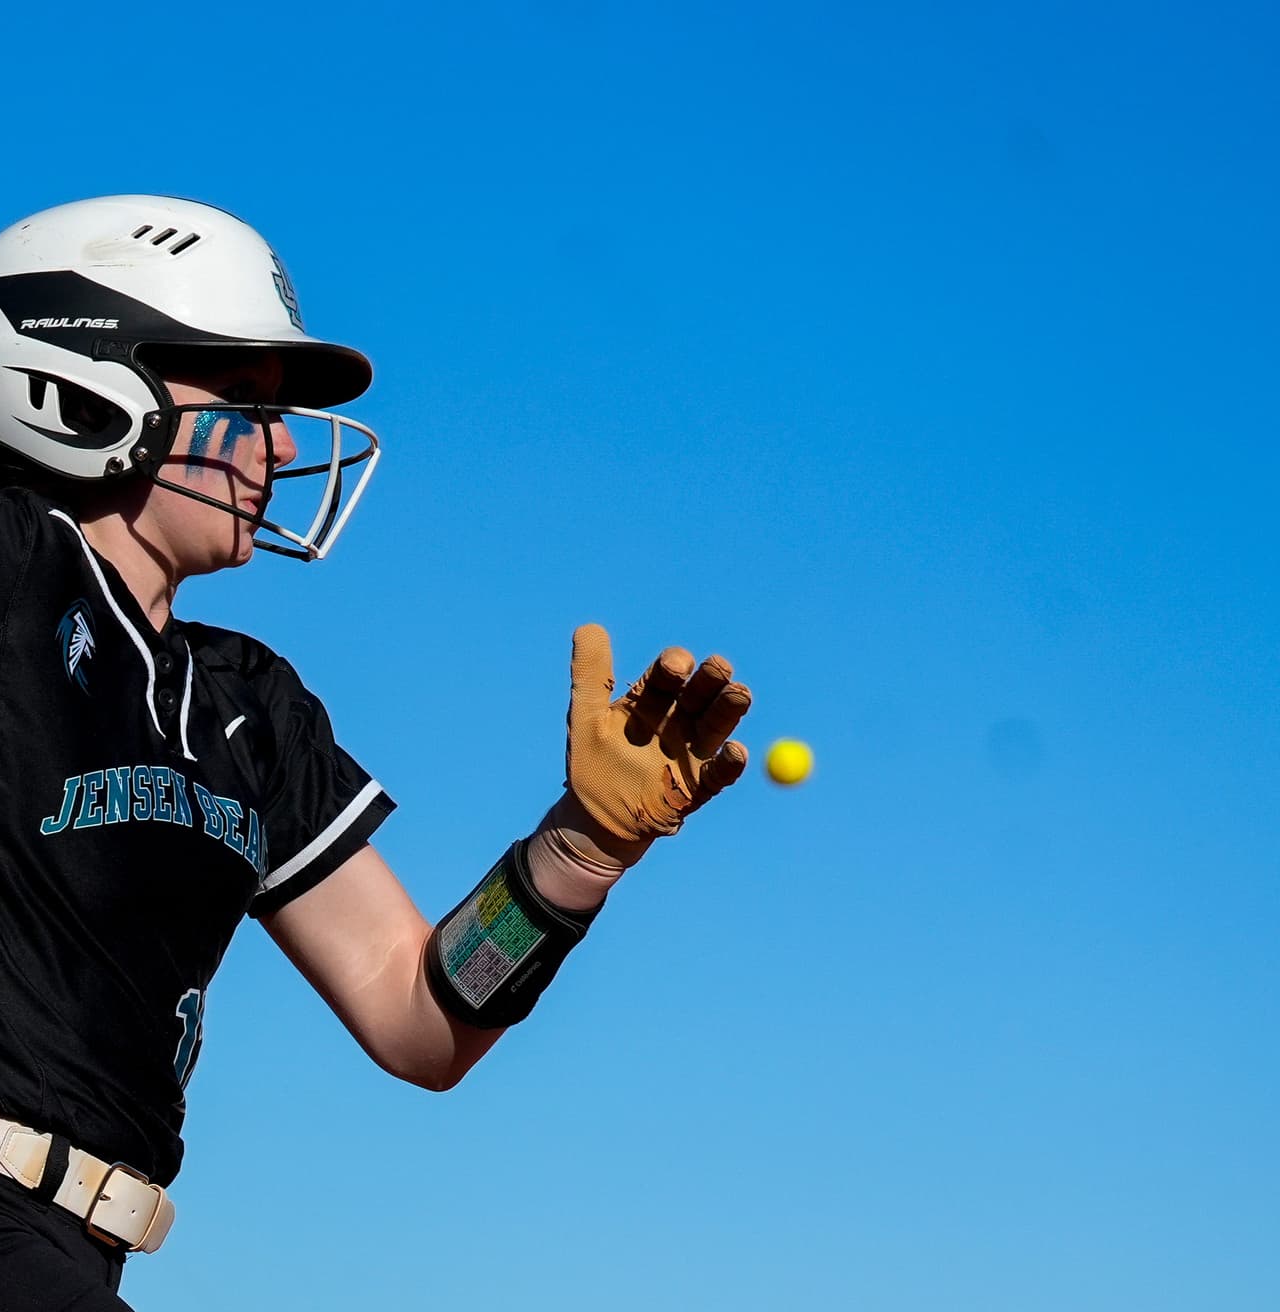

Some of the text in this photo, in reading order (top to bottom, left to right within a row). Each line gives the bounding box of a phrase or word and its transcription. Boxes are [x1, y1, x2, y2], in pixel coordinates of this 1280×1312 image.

[20, 317, 119, 330] RAWLINGS
[40, 765, 193, 836] JENSEN
[173, 987, 207, 1091] 1
